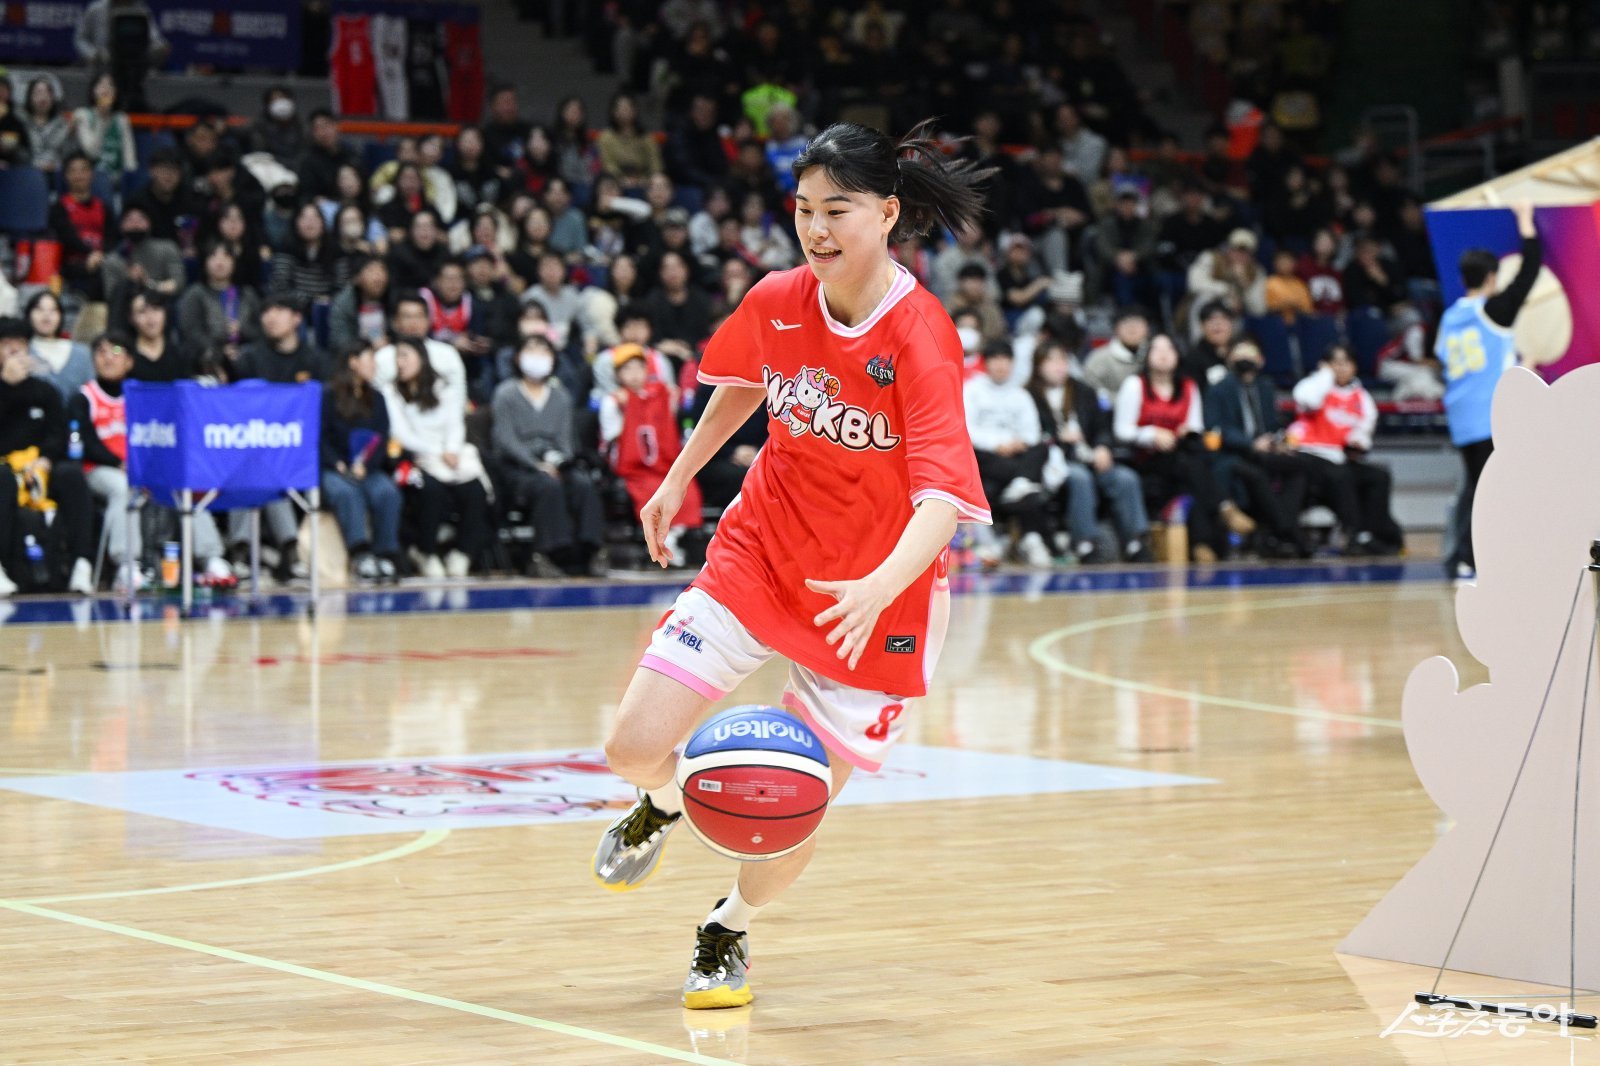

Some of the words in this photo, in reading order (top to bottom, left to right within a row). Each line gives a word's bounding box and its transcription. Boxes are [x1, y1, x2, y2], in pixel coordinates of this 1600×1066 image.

[203, 418, 303, 449] molten
[713, 720, 813, 748] molten
[865, 703, 904, 742] 8
